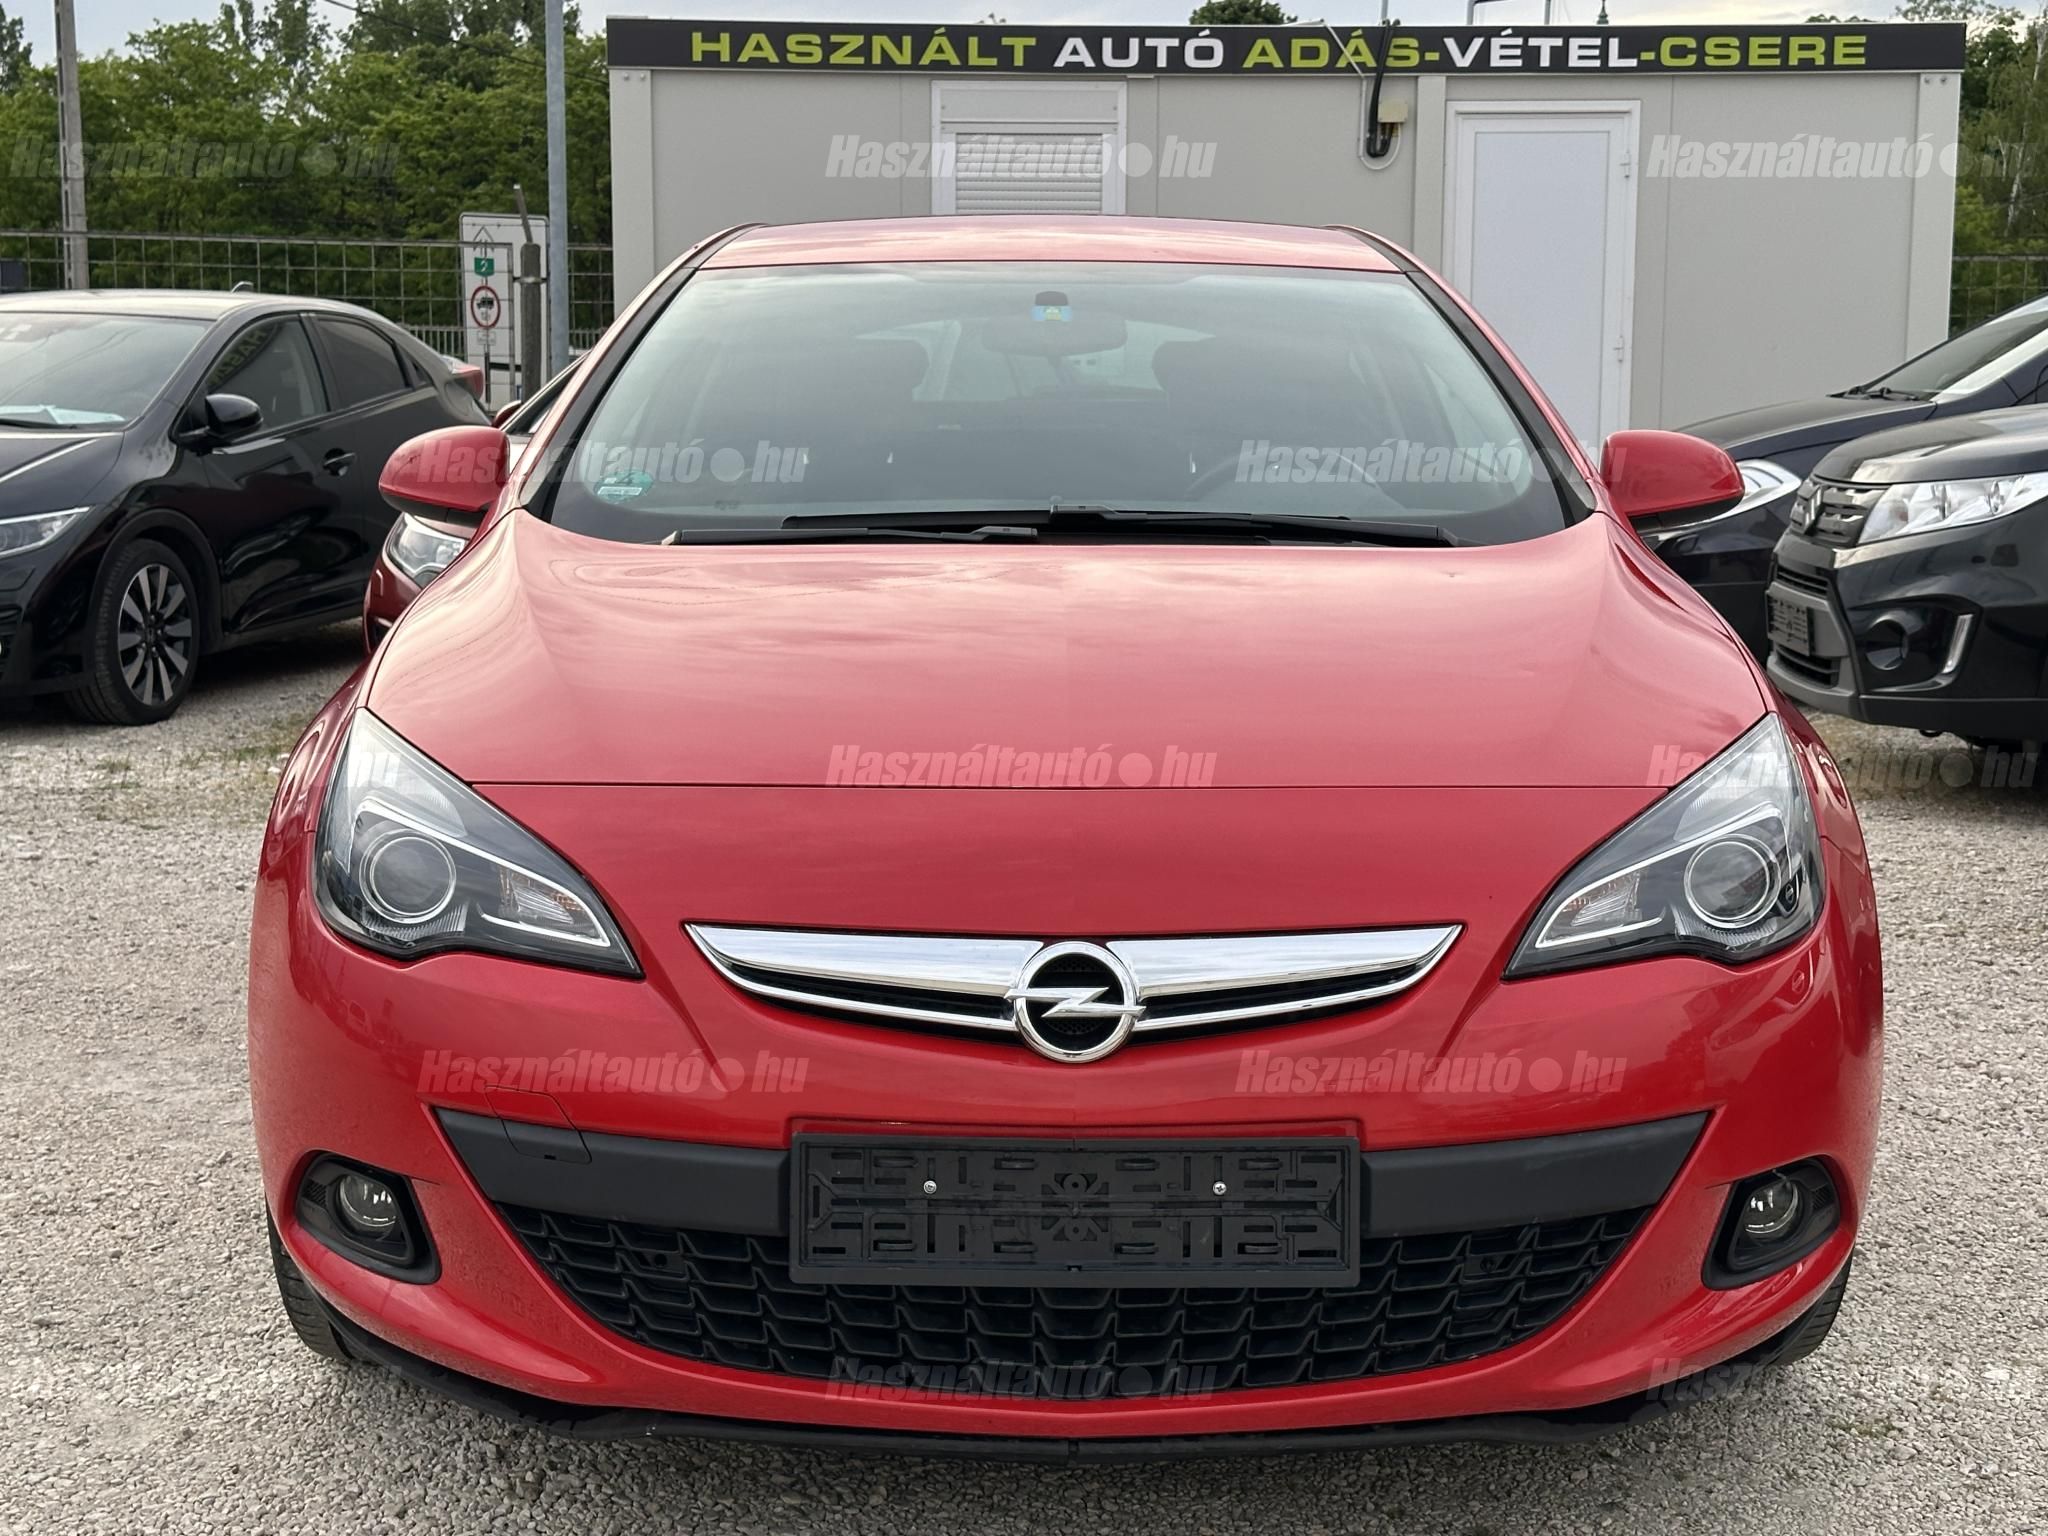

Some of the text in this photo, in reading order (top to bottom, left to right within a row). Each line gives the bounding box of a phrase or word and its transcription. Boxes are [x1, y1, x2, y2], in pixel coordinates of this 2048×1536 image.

[691, 28, 1867, 68] HASZNÁLT AUTÓ ADÁS-VÉTEL-CSERE
